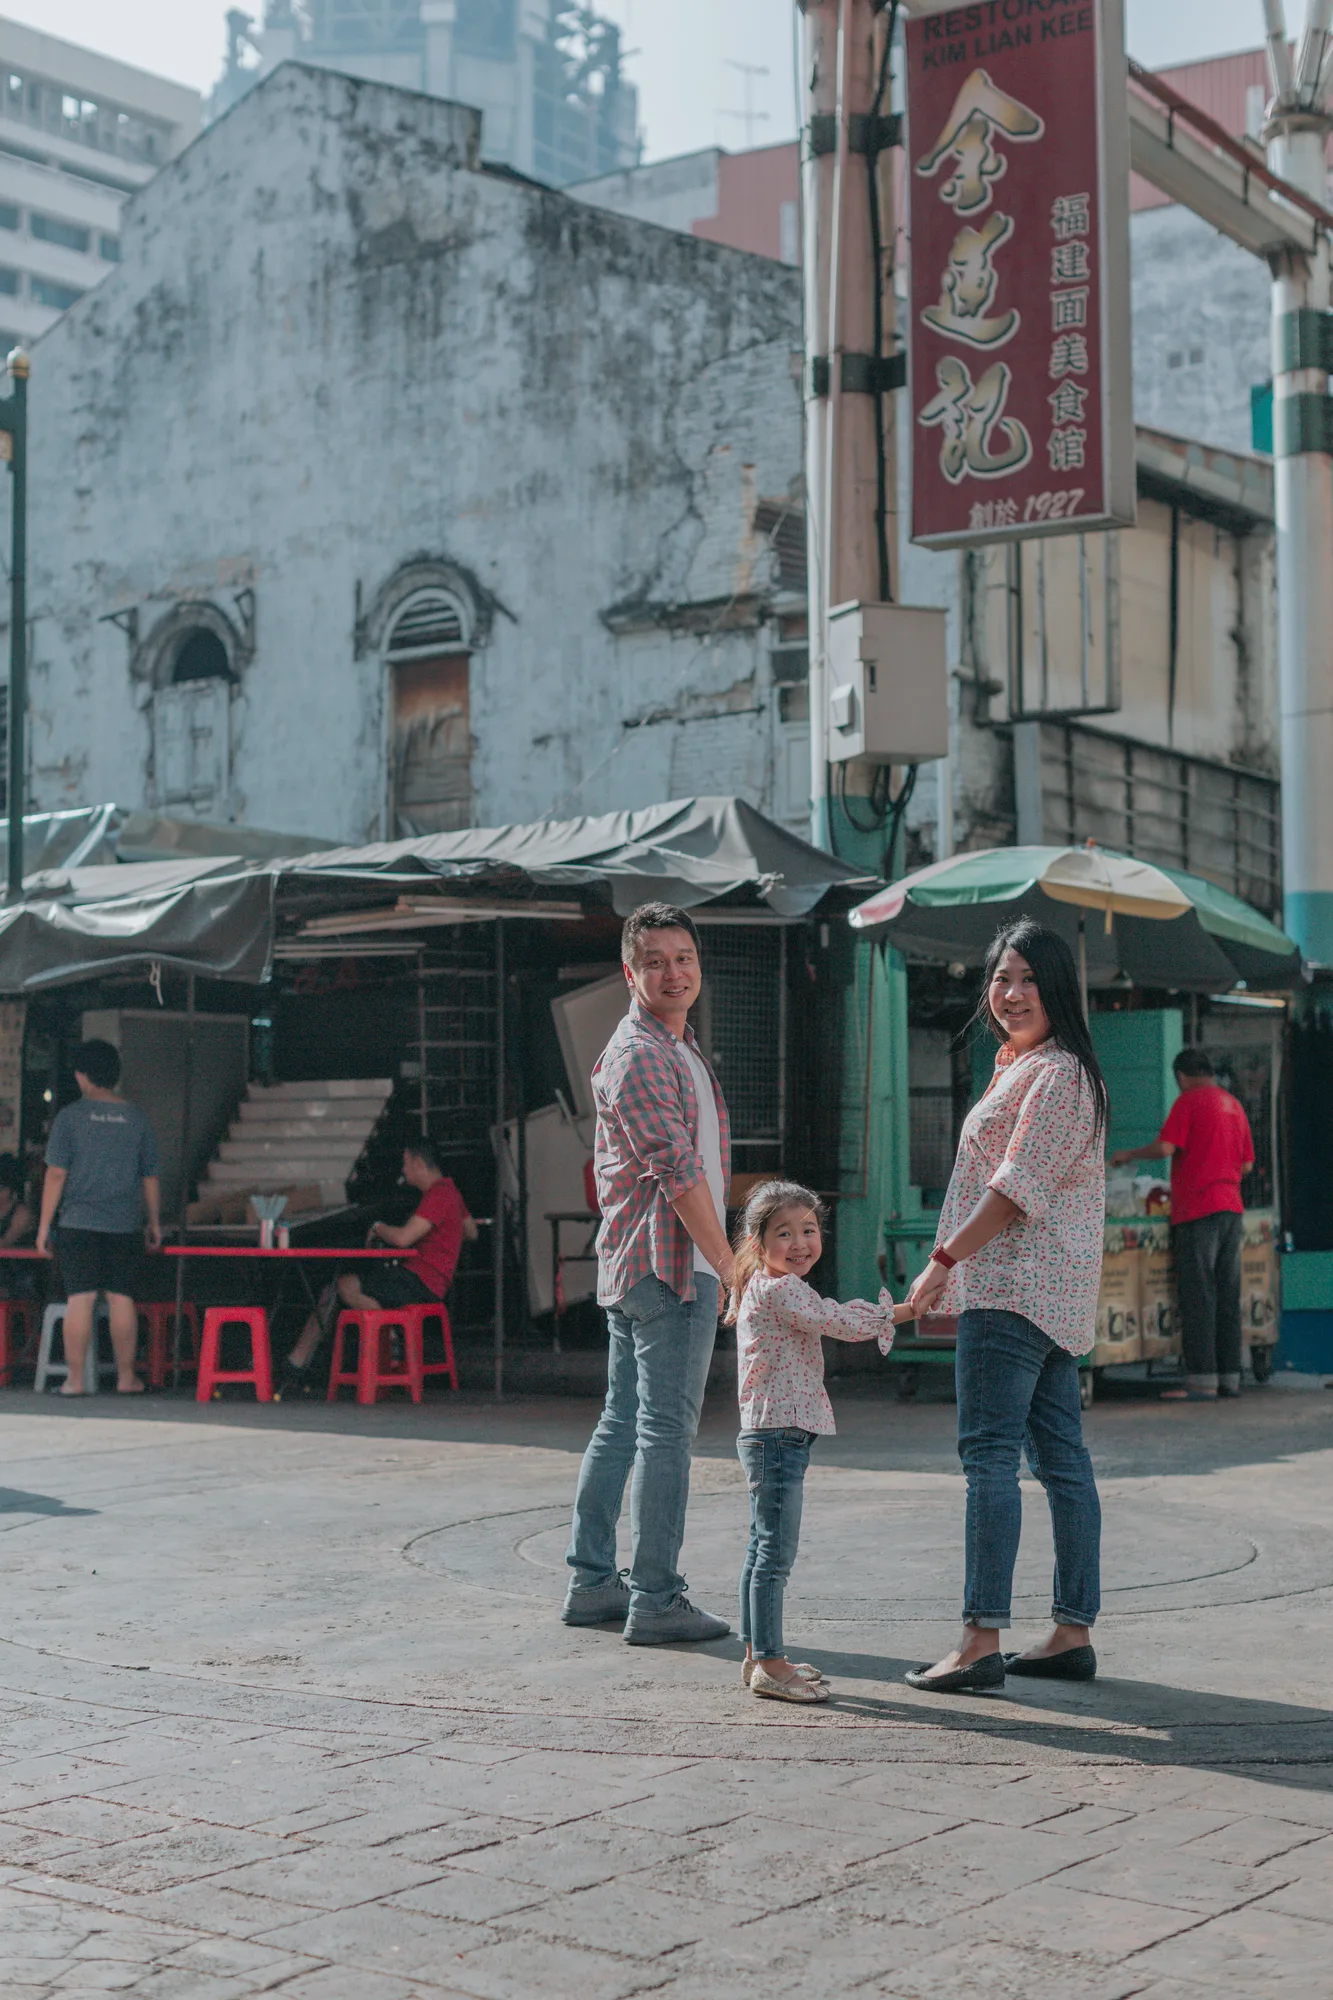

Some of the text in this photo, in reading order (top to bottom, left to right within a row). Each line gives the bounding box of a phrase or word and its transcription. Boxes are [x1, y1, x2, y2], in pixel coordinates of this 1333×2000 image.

[922, 8, 1093, 70] KIM LIAN KEE
[923, 0, 1086, 41] RESTOR
[1023, 487, 1085, 522] 1927
